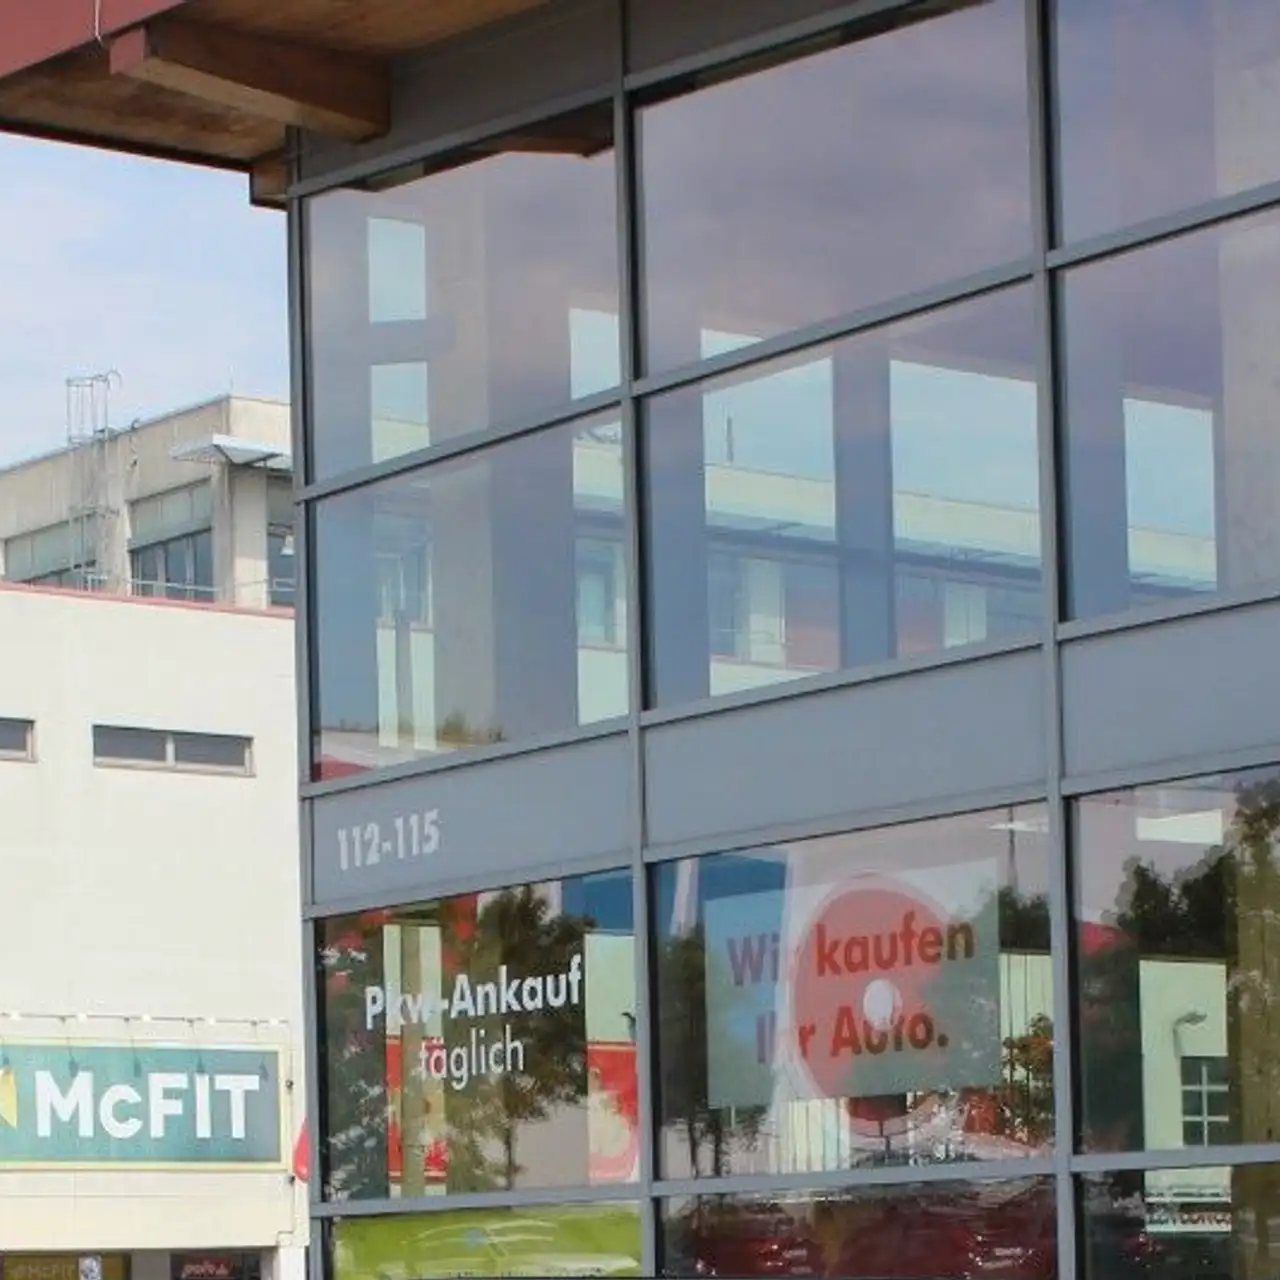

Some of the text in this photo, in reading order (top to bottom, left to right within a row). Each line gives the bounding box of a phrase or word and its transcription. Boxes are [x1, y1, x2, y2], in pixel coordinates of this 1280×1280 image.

[337, 808, 440, 870] 112-115
[727, 910, 975, 986] Wi kaufen
[365, 953, 582, 1030] Pkw-Ankauf
[420, 1023, 524, 1090] täglich
[757, 1010, 816, 1063] Ir
[35, 1070, 260, 1139] McFIT
